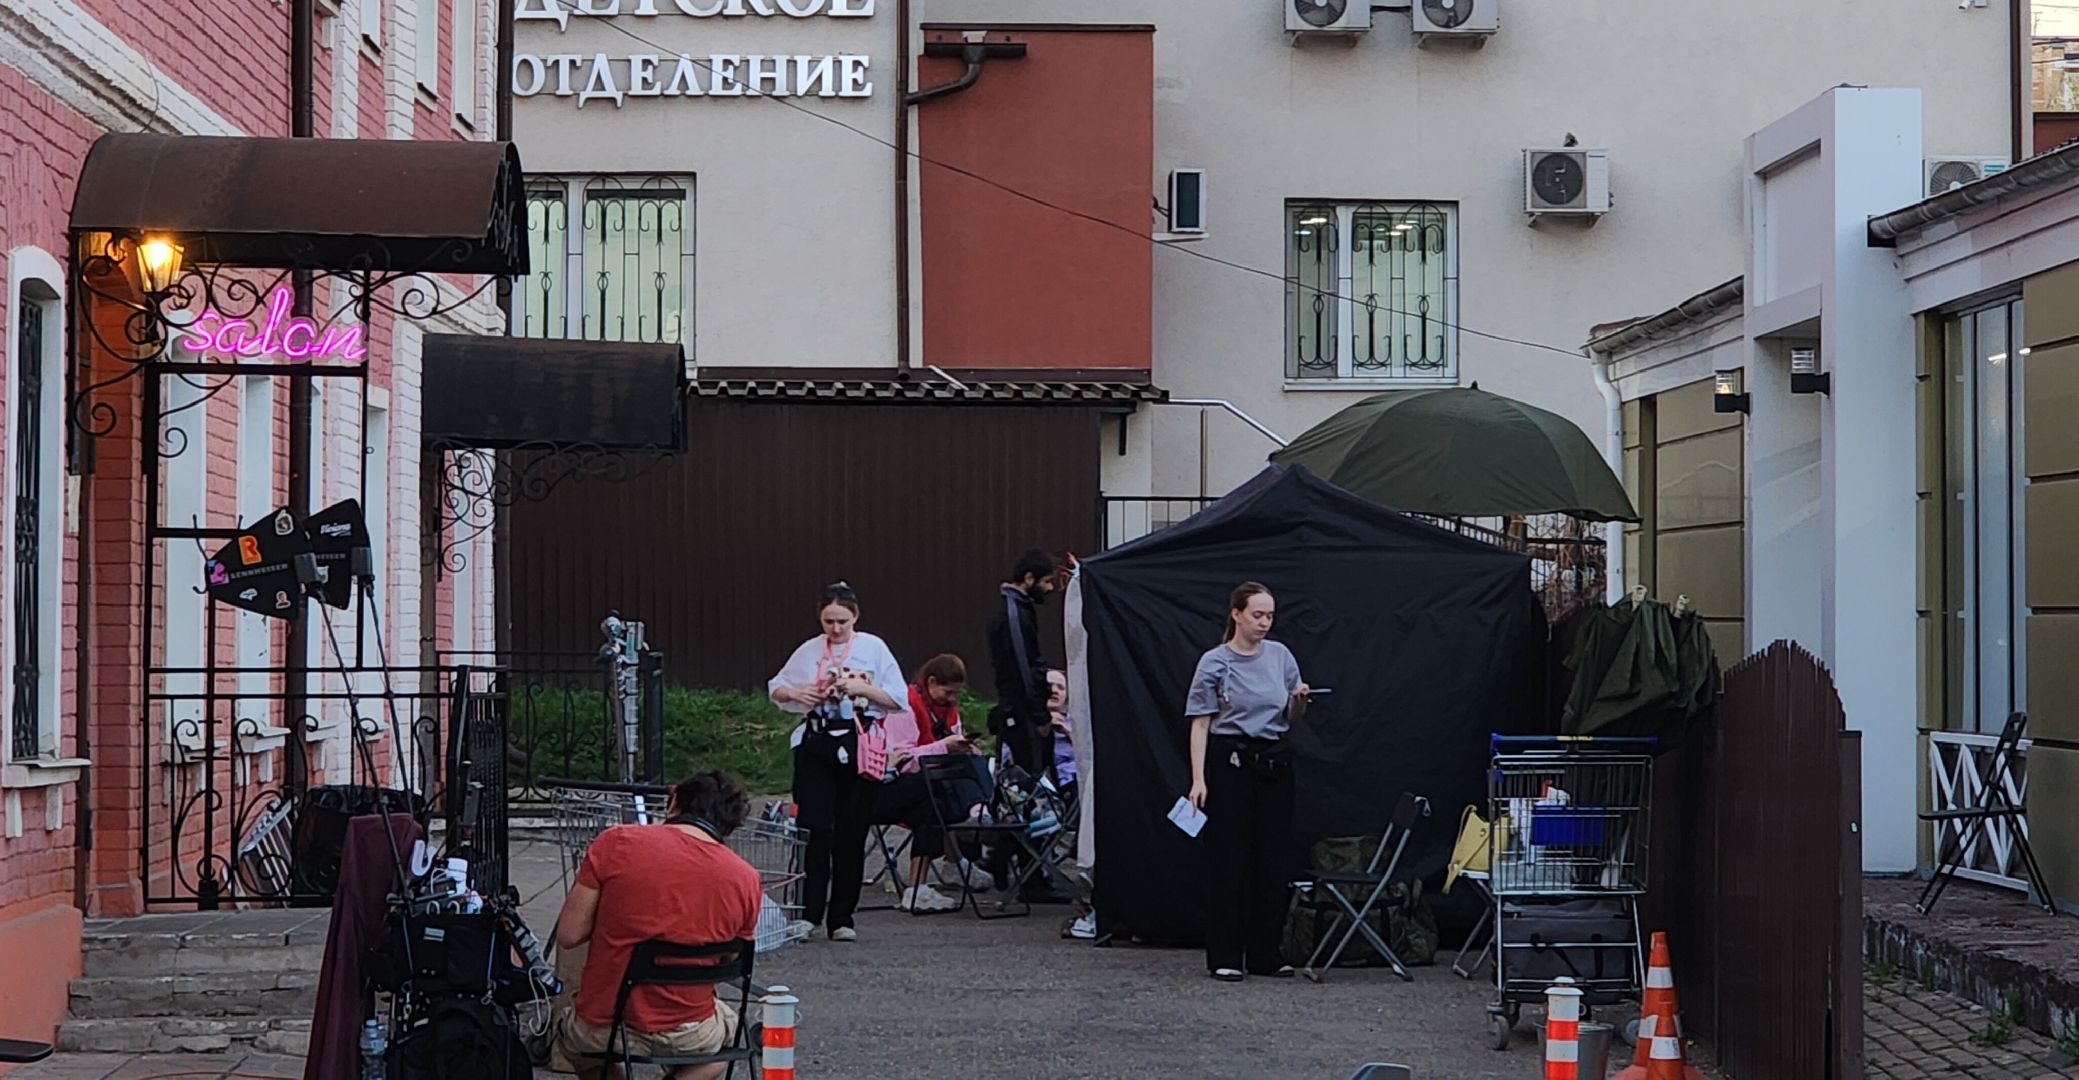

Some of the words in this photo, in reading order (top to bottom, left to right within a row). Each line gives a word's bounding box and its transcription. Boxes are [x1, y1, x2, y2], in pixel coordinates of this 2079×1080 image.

[512, 53, 873, 108] ОТДЕЛЕНИЕ
[183, 287, 367, 360] salon
[230, 563, 289, 579] SENNHEISER
